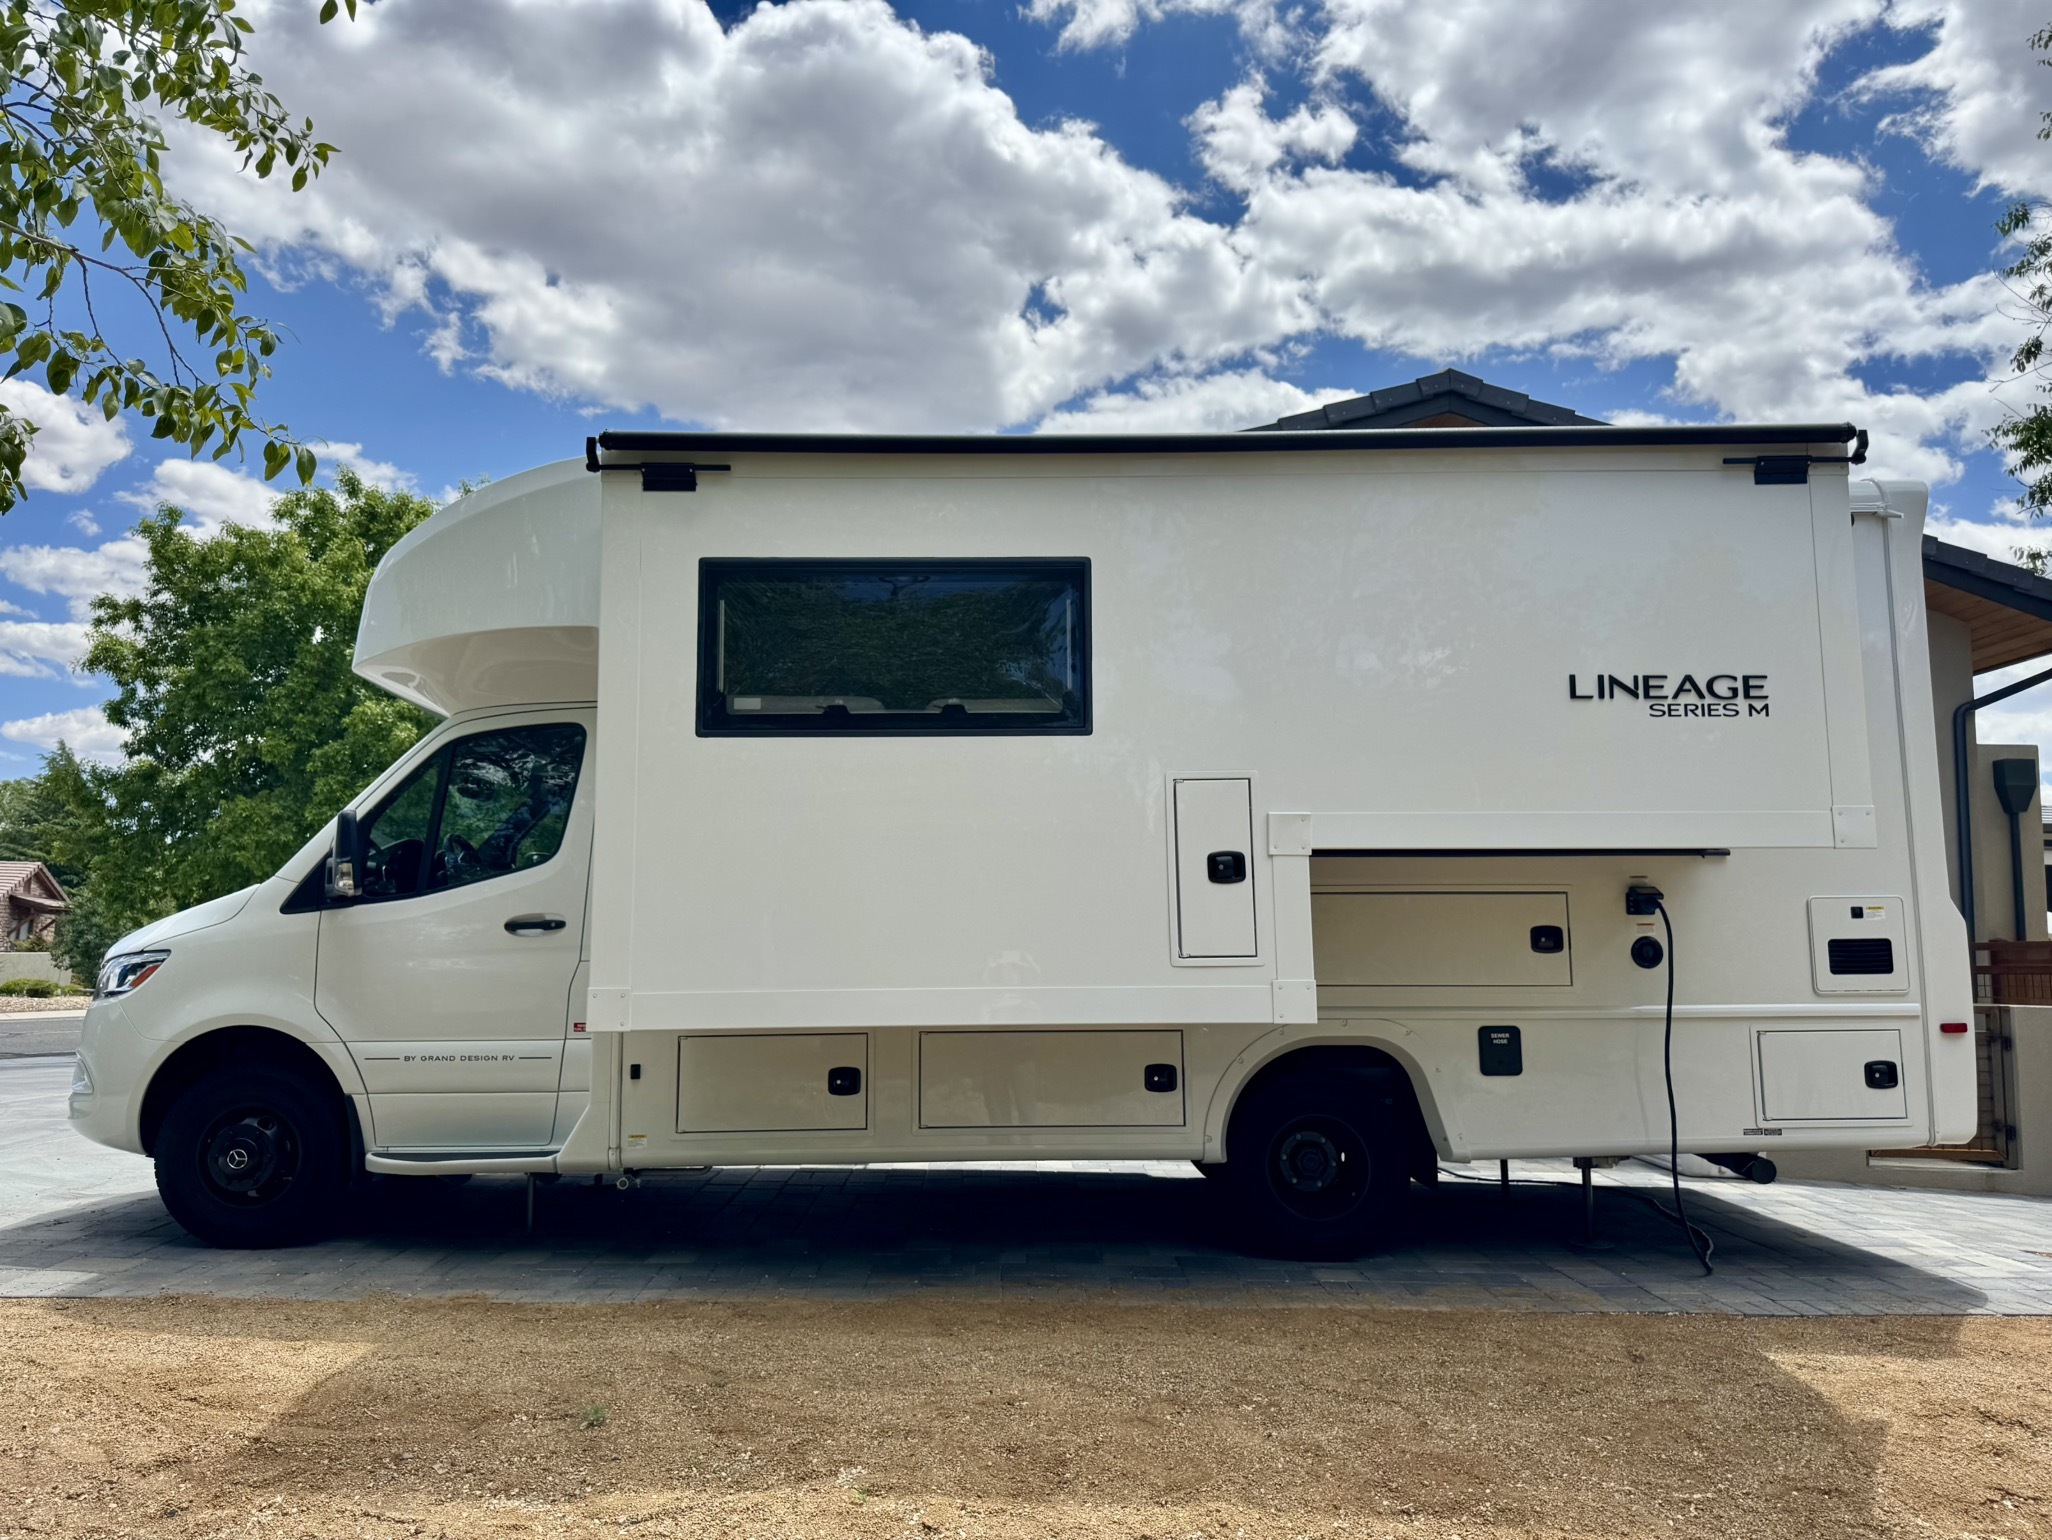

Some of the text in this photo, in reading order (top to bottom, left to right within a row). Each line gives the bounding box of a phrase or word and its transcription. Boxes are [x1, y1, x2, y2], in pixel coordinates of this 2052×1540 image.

[1569, 674, 1769, 700] LINEAGE
[1649, 703, 1770, 717] SERIES M
